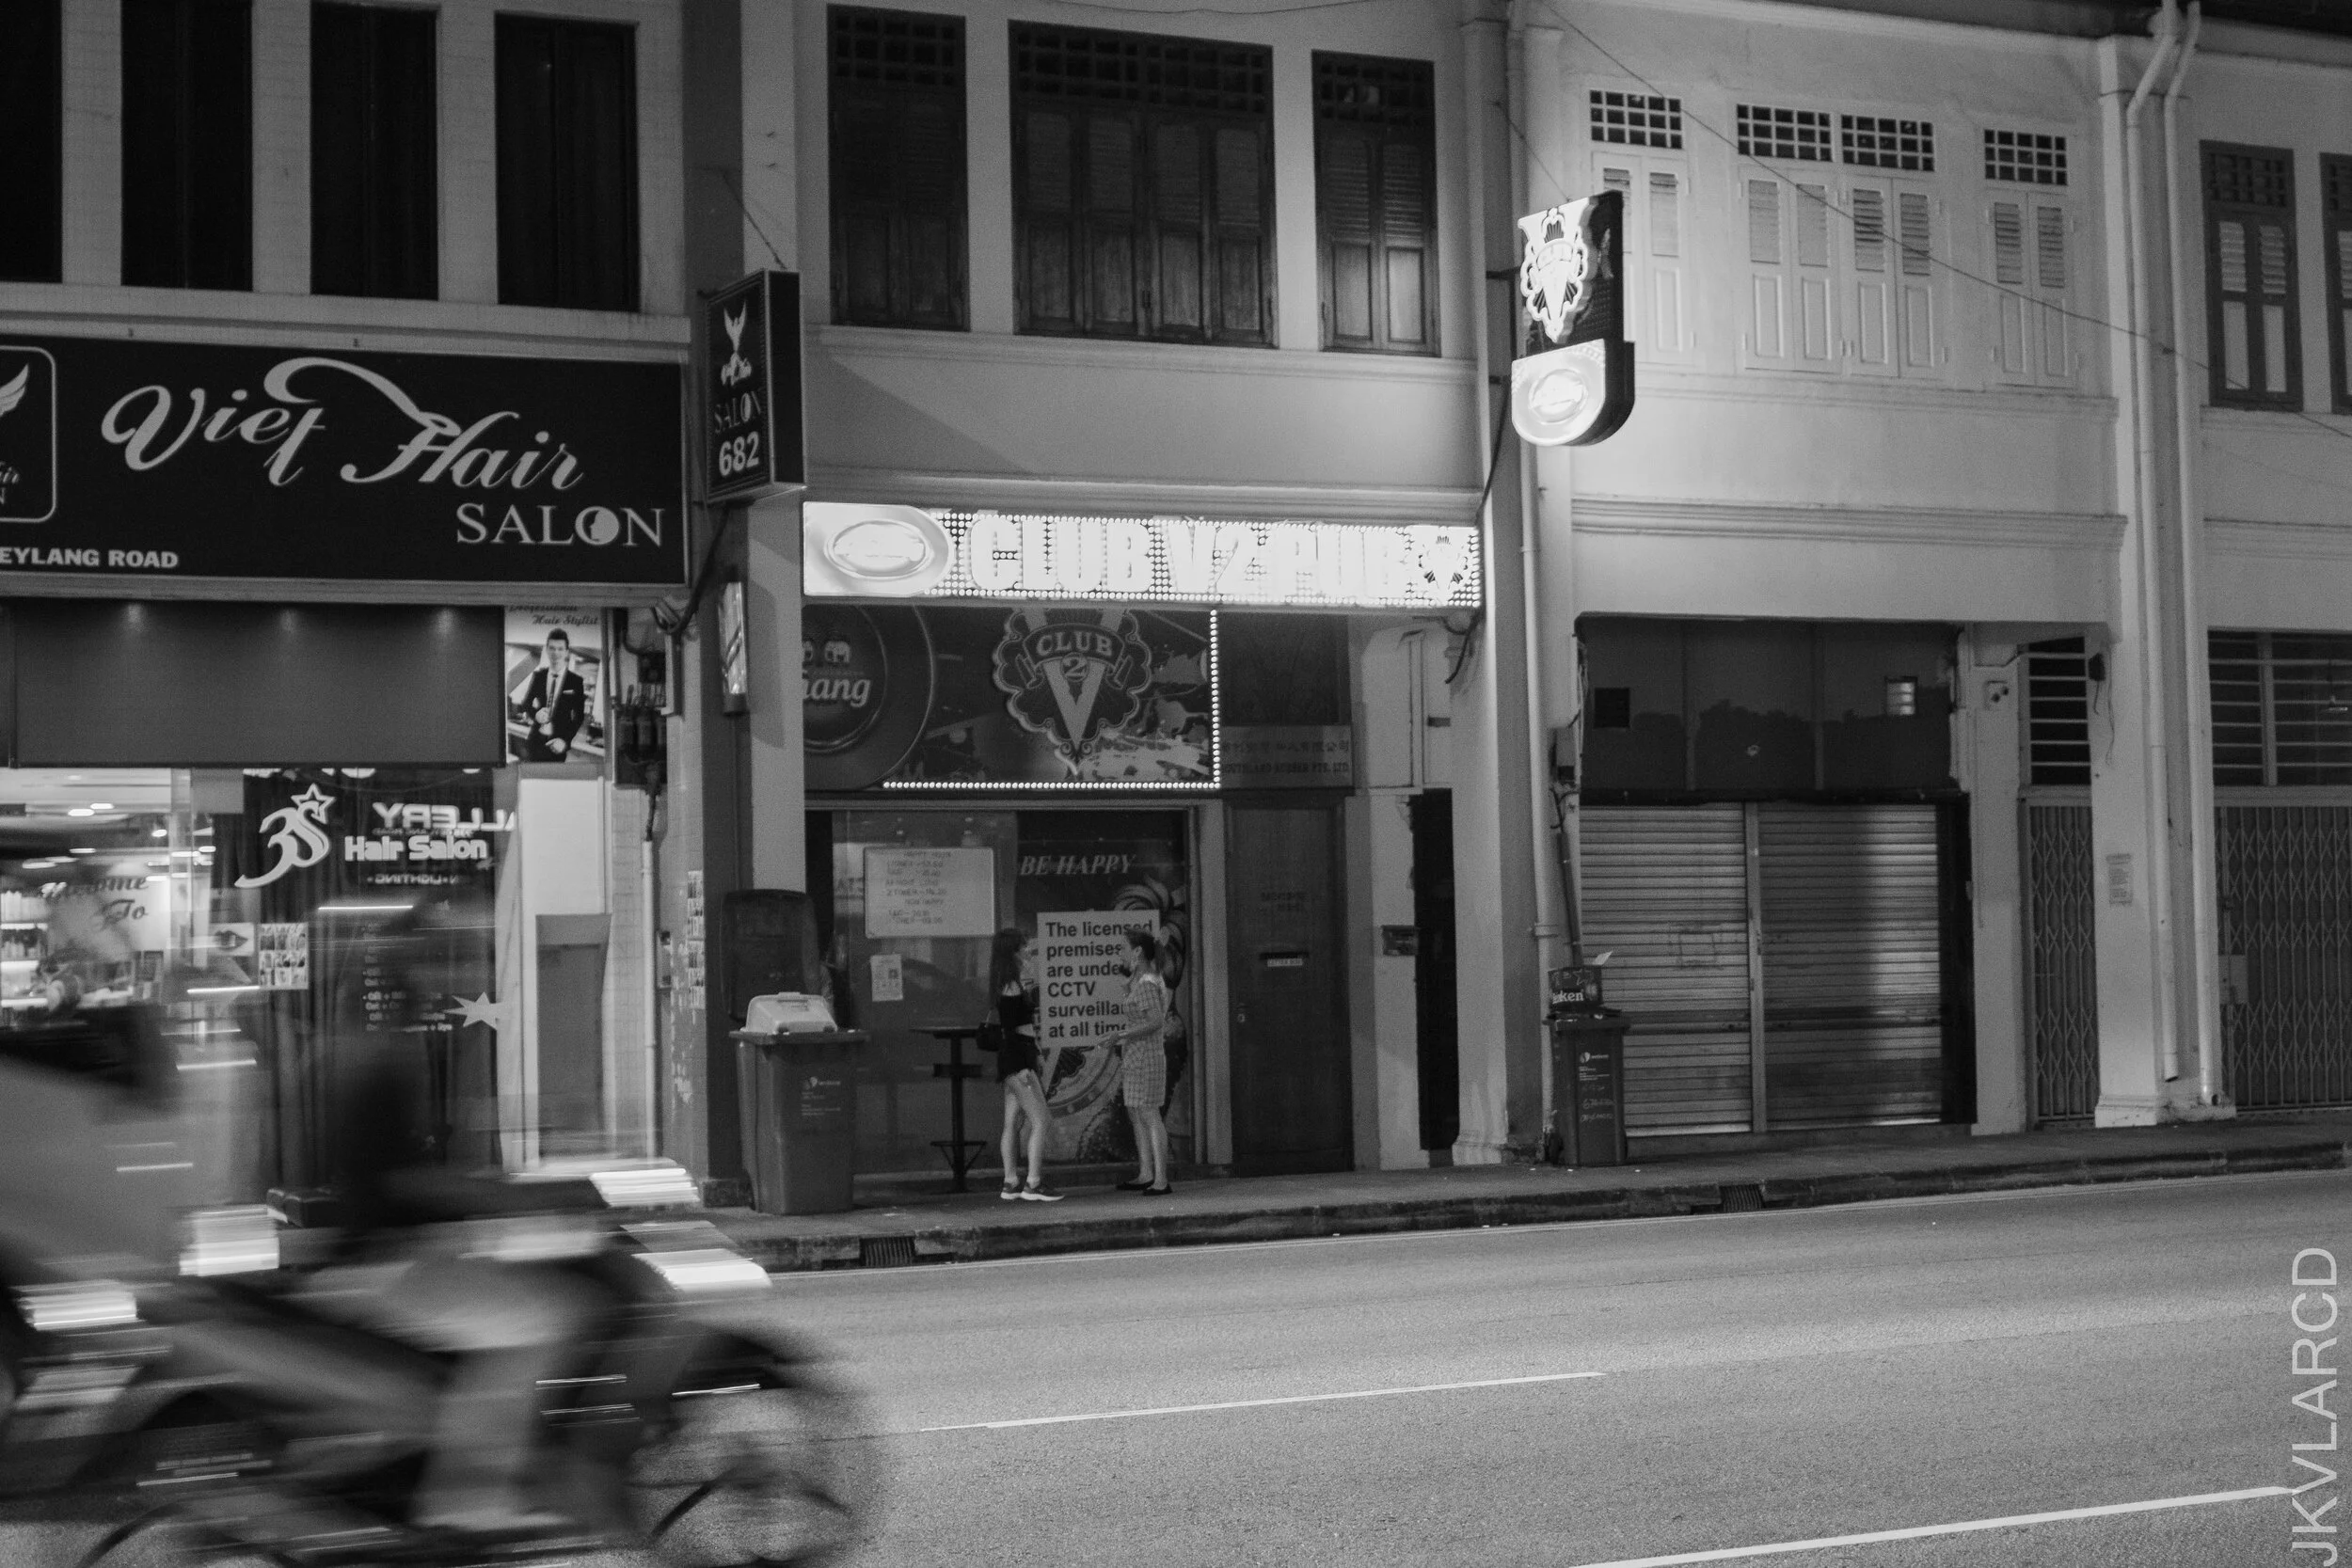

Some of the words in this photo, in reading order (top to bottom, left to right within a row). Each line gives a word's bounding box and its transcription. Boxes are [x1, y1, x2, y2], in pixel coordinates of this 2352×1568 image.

[714, 390, 761, 434] SALON
[101, 384, 326, 487] Viet
[340, 411, 583, 490] Hair
[719, 431, 759, 476] 682
[456, 503, 664, 546] SALON
[108, 549, 178, 568] ROAD
[969, 517, 1153, 592] CLUB
[1274, 525, 1406, 599] PUB
[532, 614, 560, 625] Hair
[1036, 631, 1113, 657] CLUB
[345, 835, 405, 861] Hair
[408, 835, 487, 860] Salon
[1020, 855, 1052, 876] BE
[1056, 854, 1136, 876] HAPPY
[1045, 922, 1077, 937] The
[1046, 942, 1123, 960] premises
[1047, 964, 1073, 977] are
[1079, 960, 1125, 976] unde
[1047, 981, 1096, 997] CCTV
[1048, 1001, 1124, 1017] surveilla
[1049, 1023, 1064, 1037] at
[1070, 1022, 1089, 1037] all
